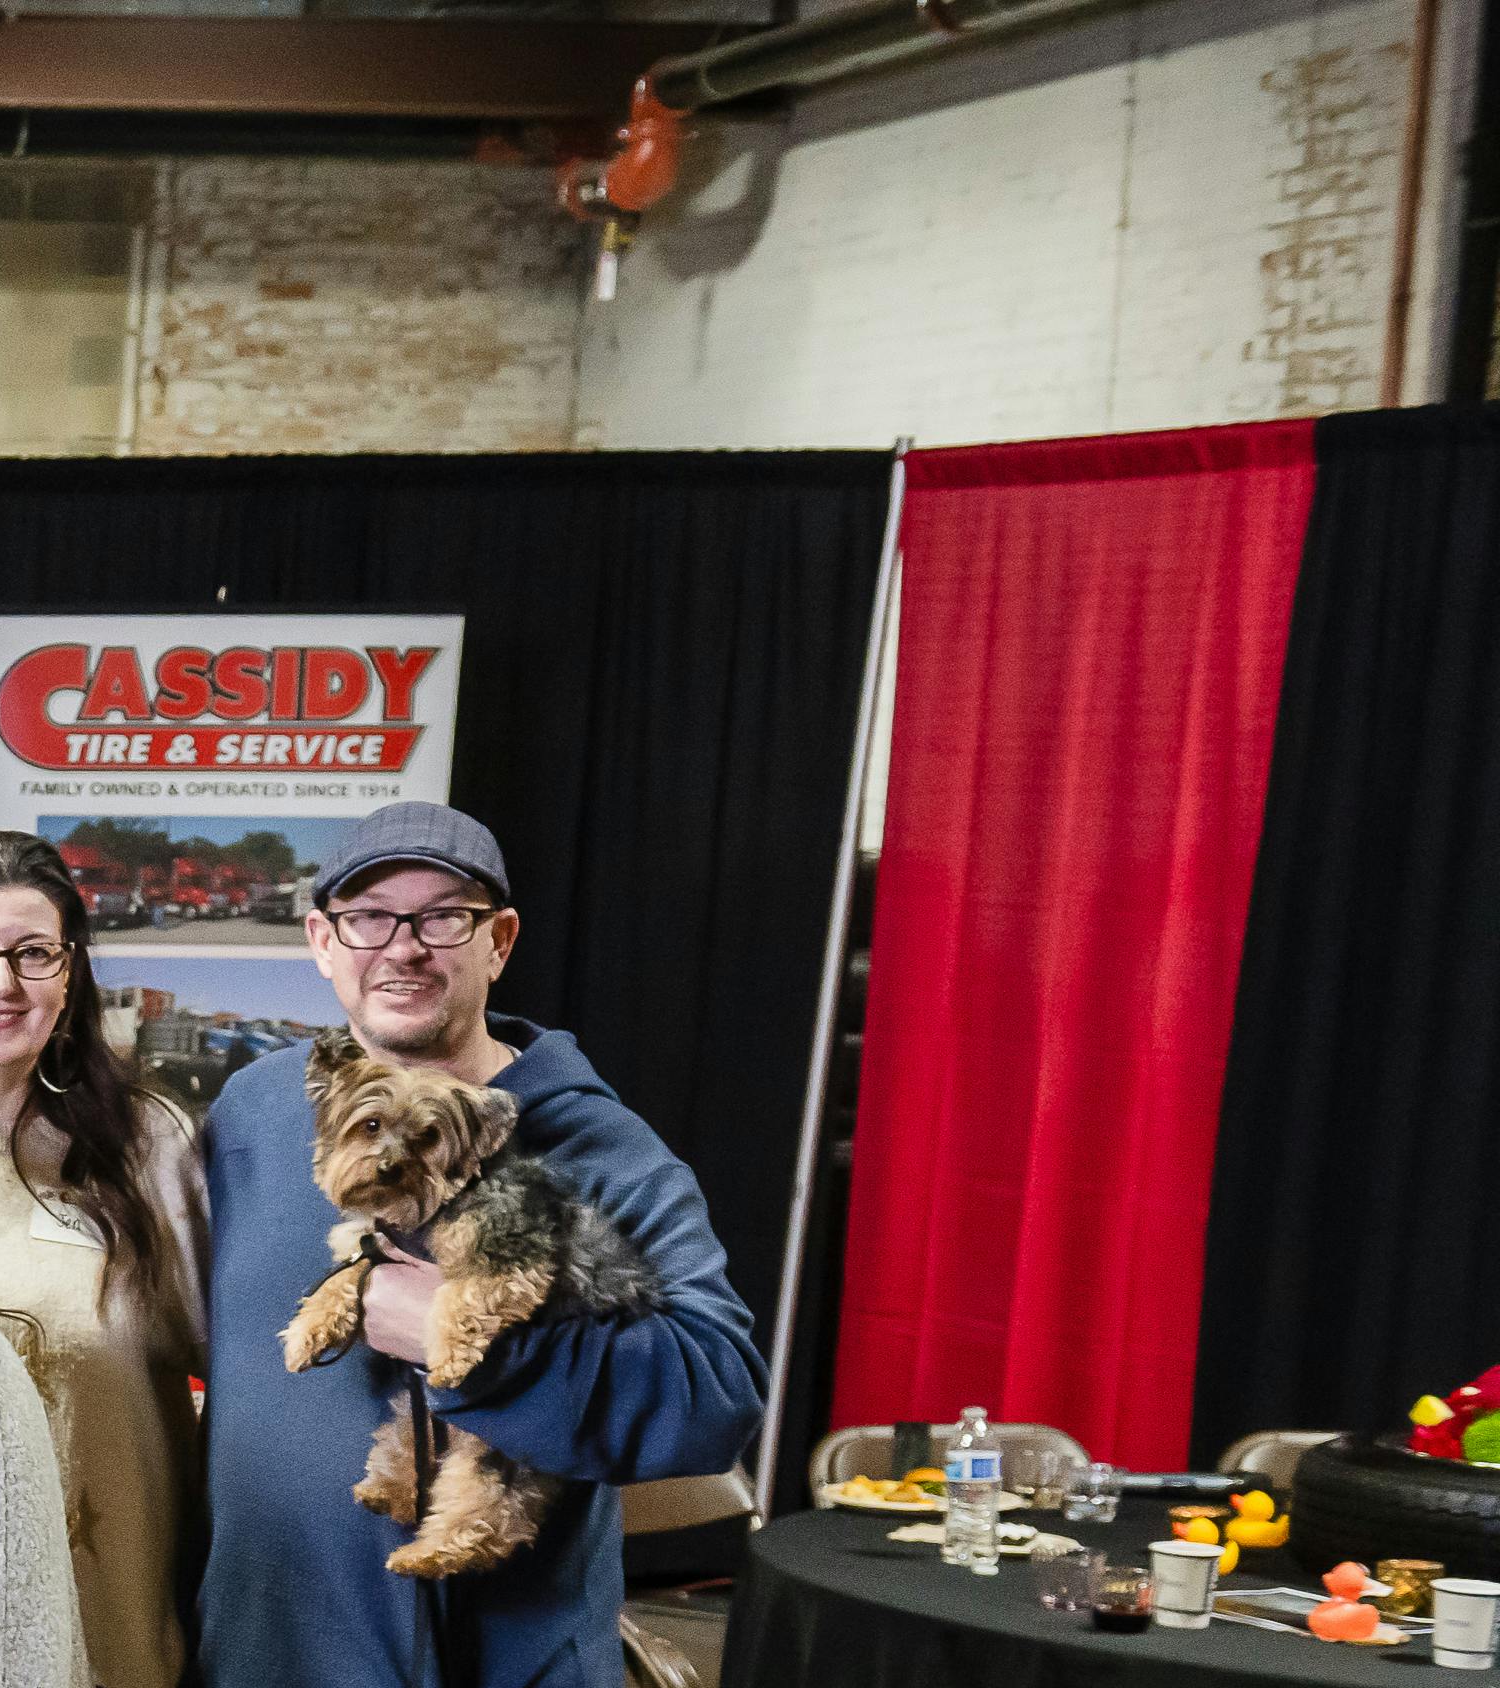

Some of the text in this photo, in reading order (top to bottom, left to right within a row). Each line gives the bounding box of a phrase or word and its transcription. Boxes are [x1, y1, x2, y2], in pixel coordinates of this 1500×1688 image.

[65, 733, 386, 765] TIRE & SERVICE
[19, 781, 83, 796] FAMILY
[89, 781, 162, 796] OWNED
[168, 781, 180, 796] &
[184, 781, 288, 797] OPERATED
[294, 782, 349, 797] SINCE
